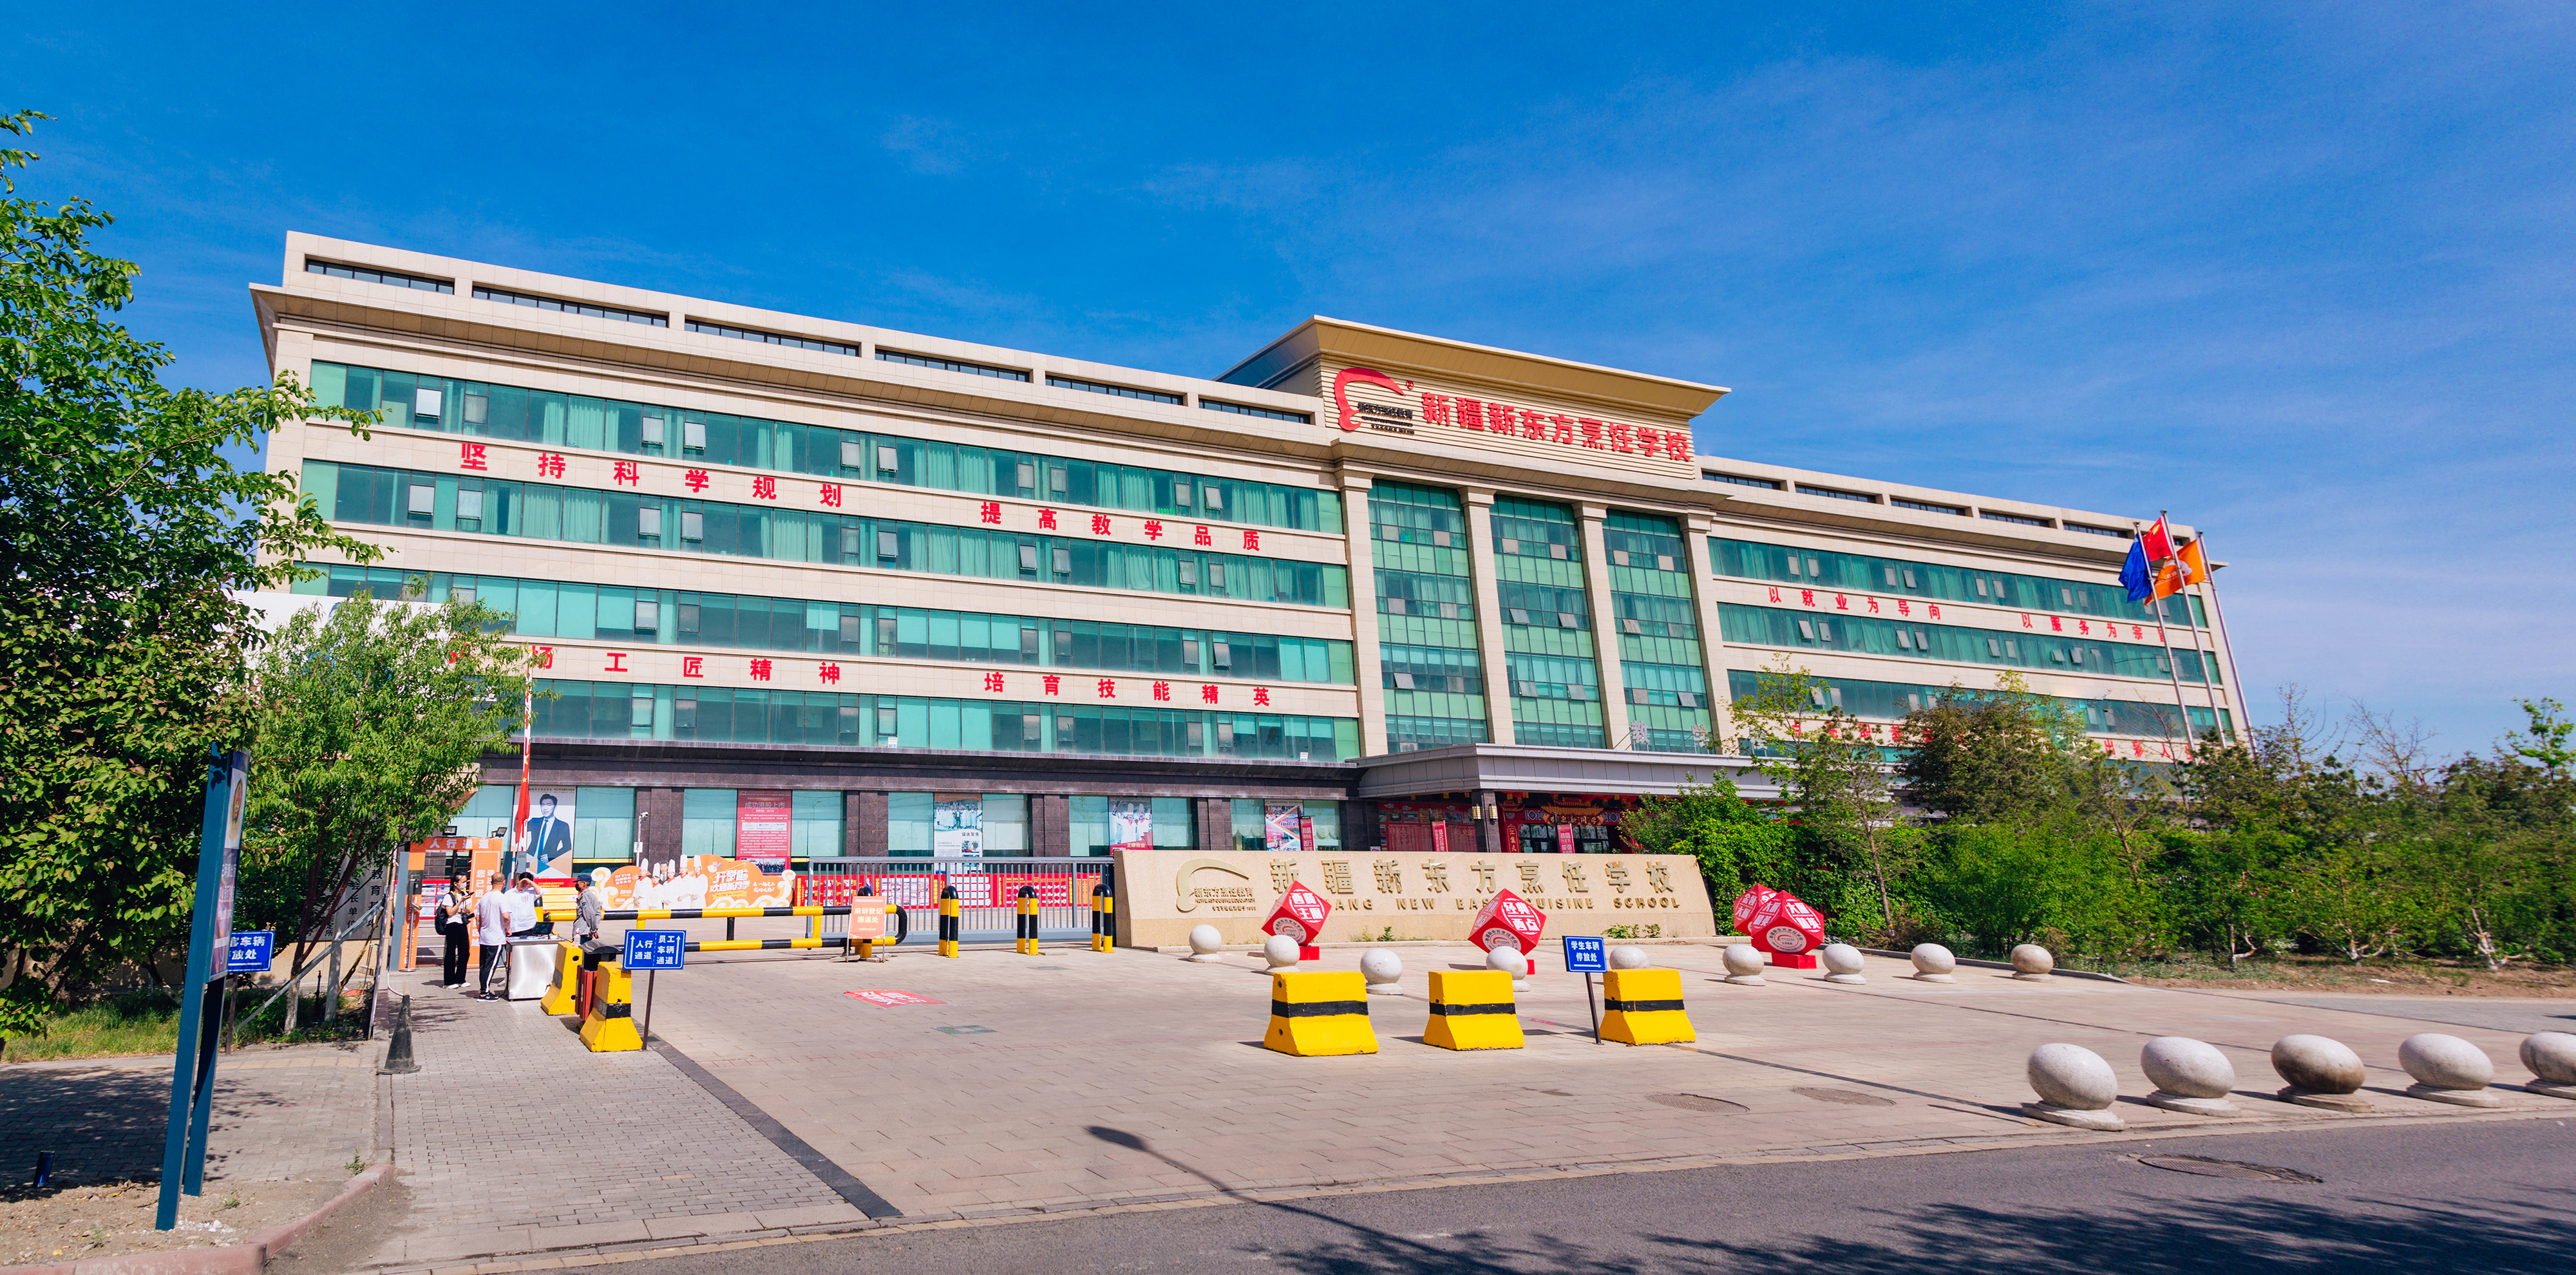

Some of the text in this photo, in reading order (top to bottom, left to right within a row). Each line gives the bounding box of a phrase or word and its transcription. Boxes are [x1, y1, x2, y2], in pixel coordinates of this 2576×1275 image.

[1421, 392, 1691, 462] 新疆新东方烹饪学校
[460, 442, 842, 507] 坚持科学规划
[981, 501, 1260, 552] 提高教学品质
[1768, 586, 1941, 620] 以就业为导向
[449, 643, 840, 685] 扬工匠精神
[984, 671, 1270, 706] 培育技能精英
[430, 838, 489, 849] 人行通道
[712, 869, 748, 884] 开学啦
[1269, 858, 1674, 894] 新疆新东方烹饪学校
[709, 880, 750, 892] 欢迎新同学
[1194, 887, 1253, 898] 新东方烹饪教育
[1291, 892, 1317, 904] 西餐
[471, 869, 486, 947] 您已进区域
[1396, 898, 1435, 909] NEW
[1455, 898, 1490, 910] EAS
[1613, 897, 1680, 909] SCHOOL
[1503, 902, 1531, 914] 经典
[1298, 908, 1324, 920] 主厨
[1511, 918, 1540, 931] 西点
[636, 940, 653, 949] 人行
[658, 935, 675, 943] 员工
[1571, 941, 1600, 950] 学生车辆
[229, 949, 257, 960] 放处
[656, 956, 674, 965] 通道
[1576, 952, 1597, 962] 停放处
